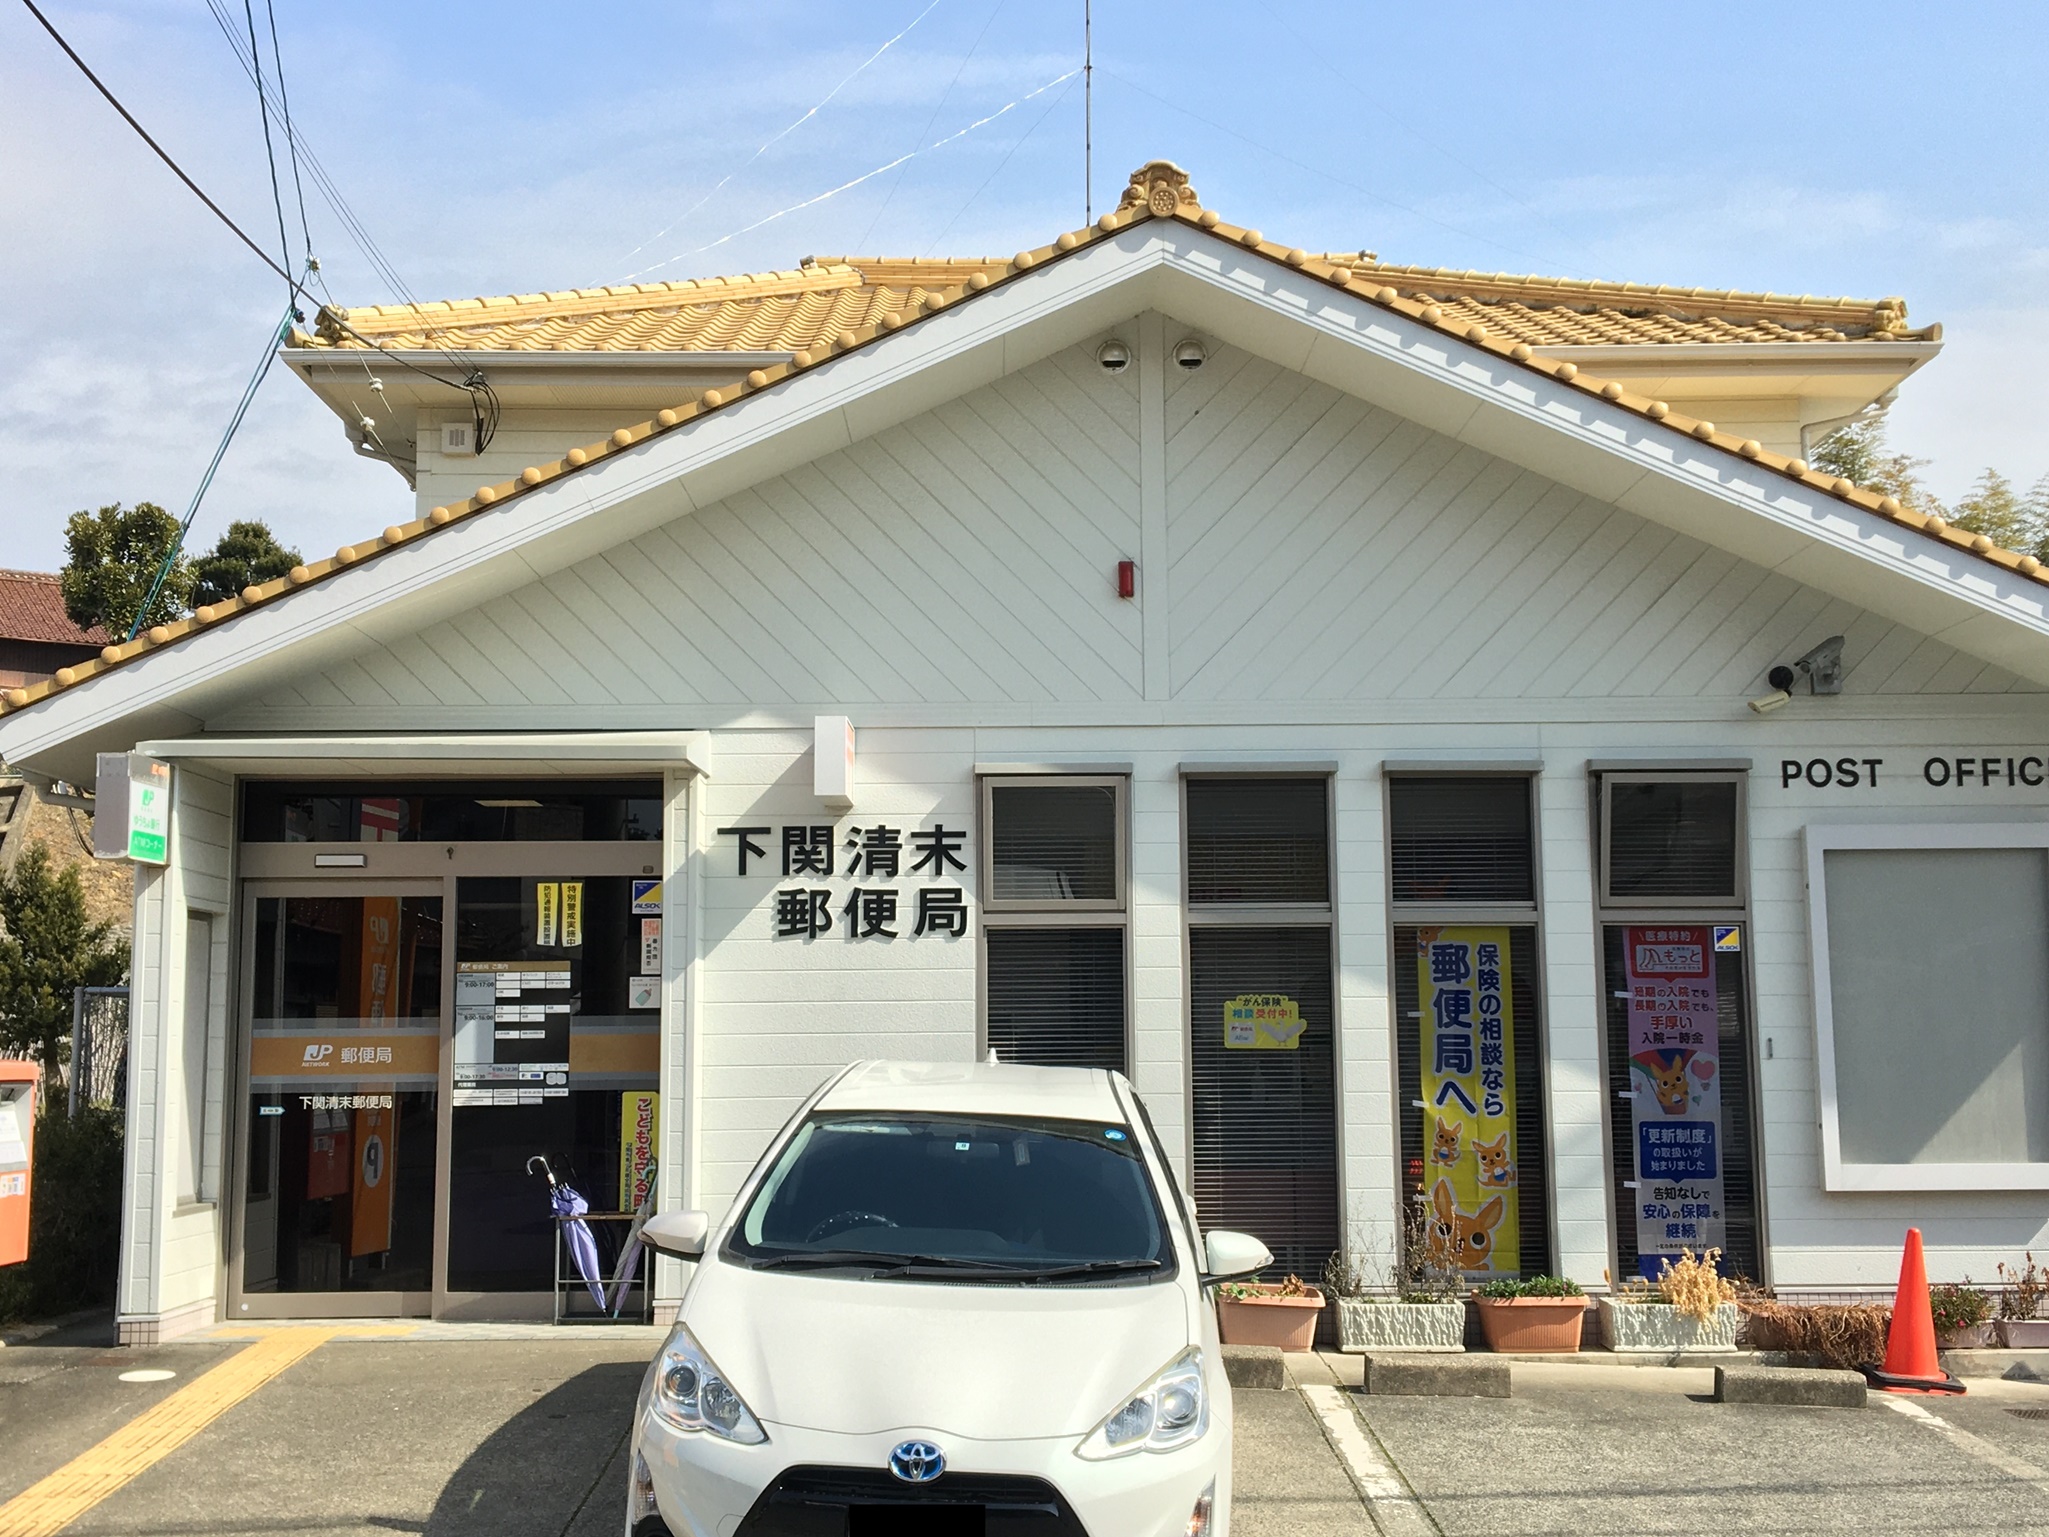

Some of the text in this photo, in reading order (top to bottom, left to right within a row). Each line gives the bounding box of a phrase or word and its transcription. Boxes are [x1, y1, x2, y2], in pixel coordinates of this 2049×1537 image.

[1782, 757, 2049, 788] POST OFFIC
[717, 824, 967, 877] 下関清末
[777, 887, 968, 939] 郵便局
[1663, 949, 1700, 963] もっと
[1634, 986, 1709, 998] 短期の入院でも
[1431, 943, 1477, 1114] 郵便局へ
[1477, 944, 1504, 1116] 保険の相談なら
[1651, 1015, 1693, 1030] 手厚い
[1642, 1032, 1704, 1044] 入院一時金
[303, 1045, 392, 1063] JP 郵便局
[299, 1096, 392, 1109] 下関清末郵便局
[1653, 1147, 1702, 1158] の取扱いが
[1651, 1161, 1706, 1171] 始まりました
[1653, 1187, 1710, 1200] 告知なしで
[1643, 1204, 1720, 1219] 安心の保障を
[1665, 1223, 1697, 1238] 継続
